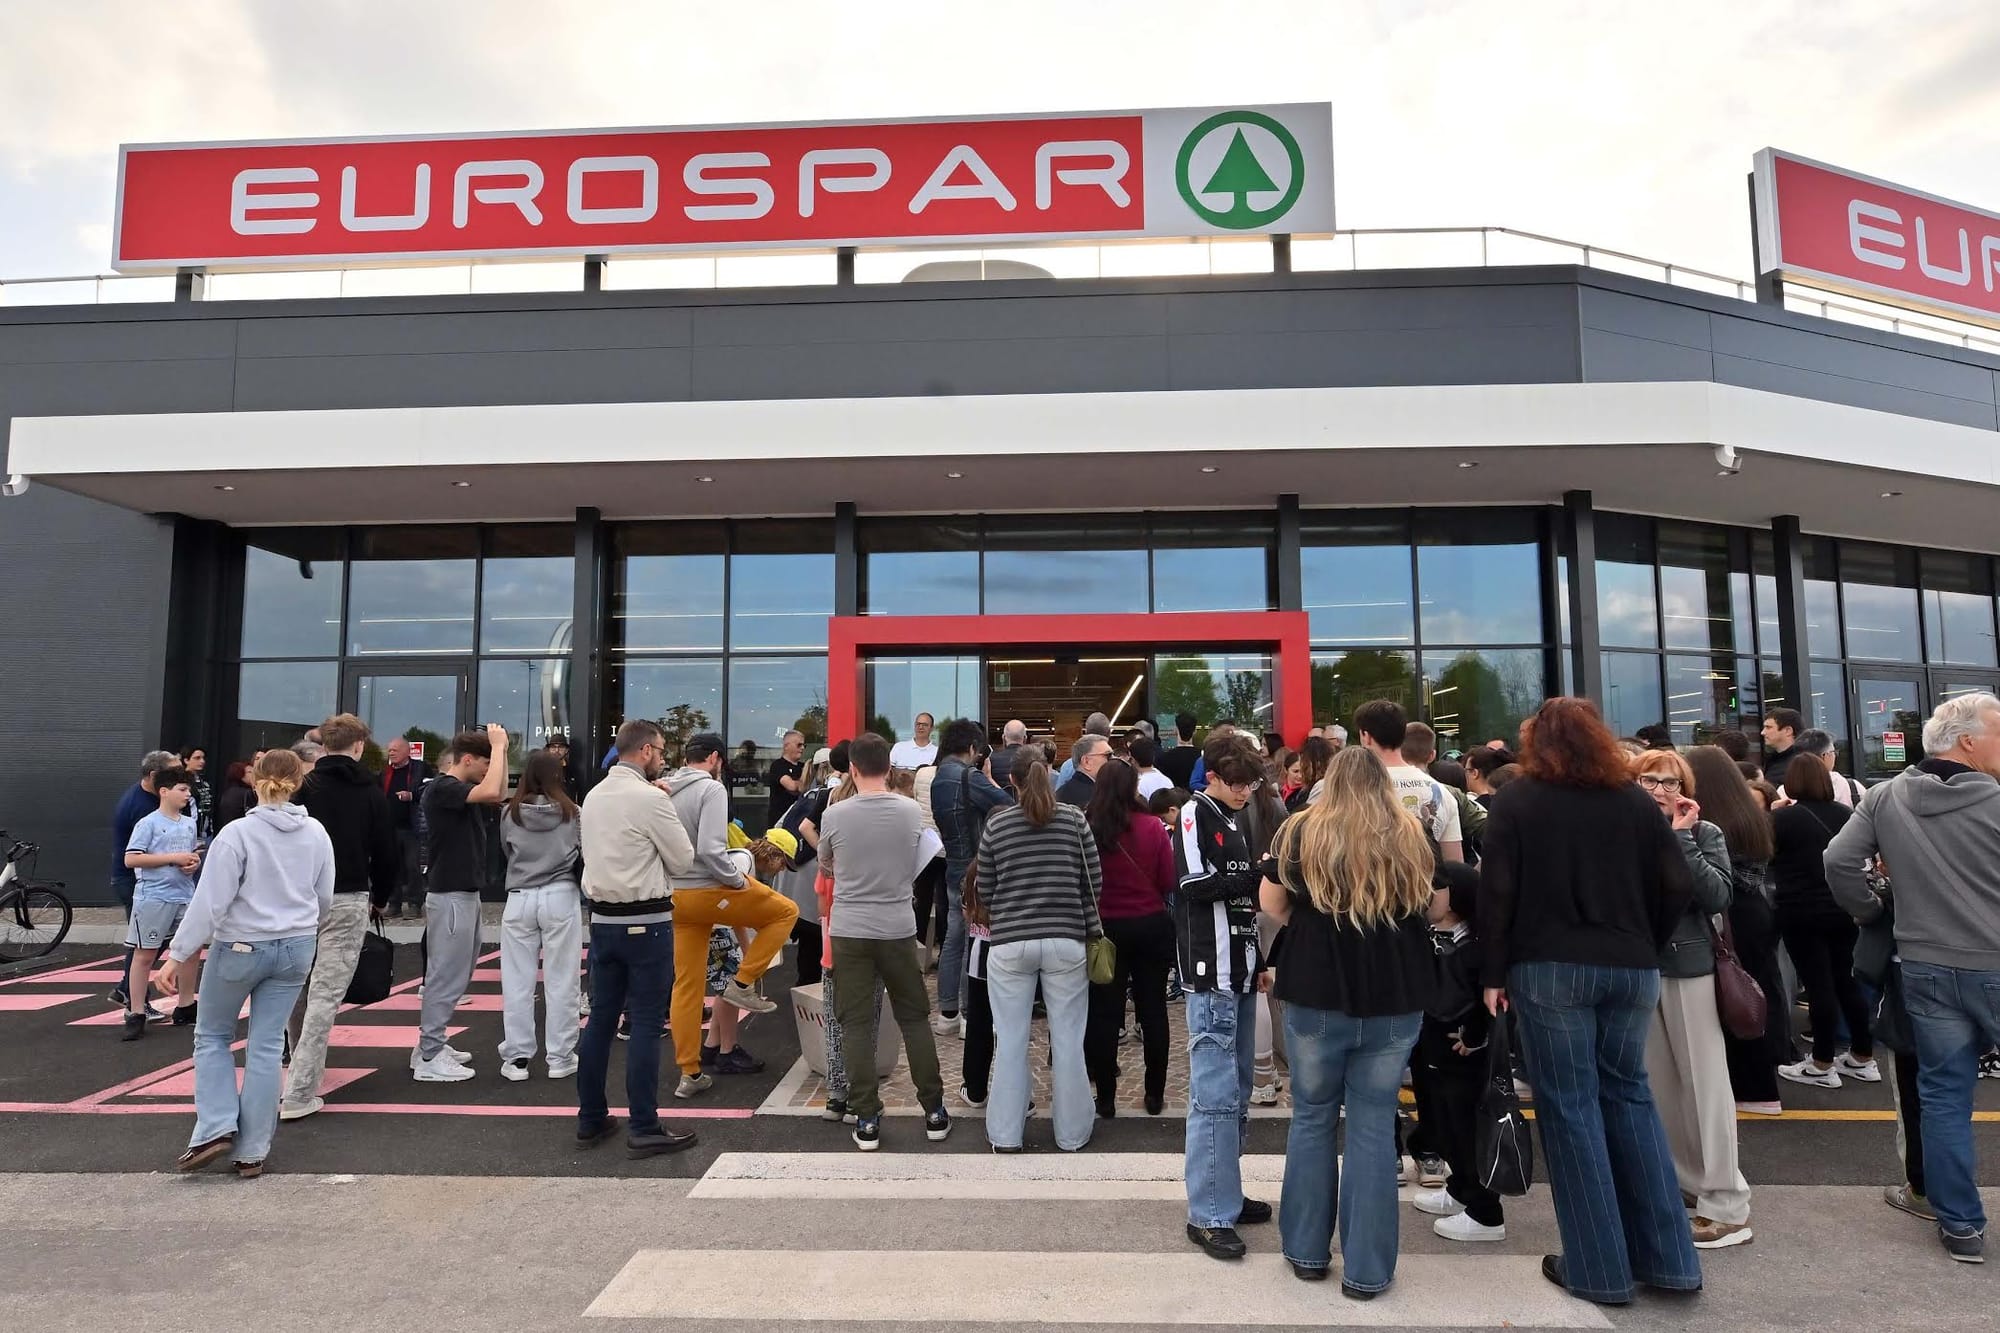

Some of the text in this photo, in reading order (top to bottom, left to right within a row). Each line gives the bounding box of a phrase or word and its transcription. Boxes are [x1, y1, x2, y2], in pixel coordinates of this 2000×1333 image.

[230, 140, 1131, 236] EUROSPAR
[535, 725, 571, 738] PANE
[1226, 860, 1251, 871] IO SON
